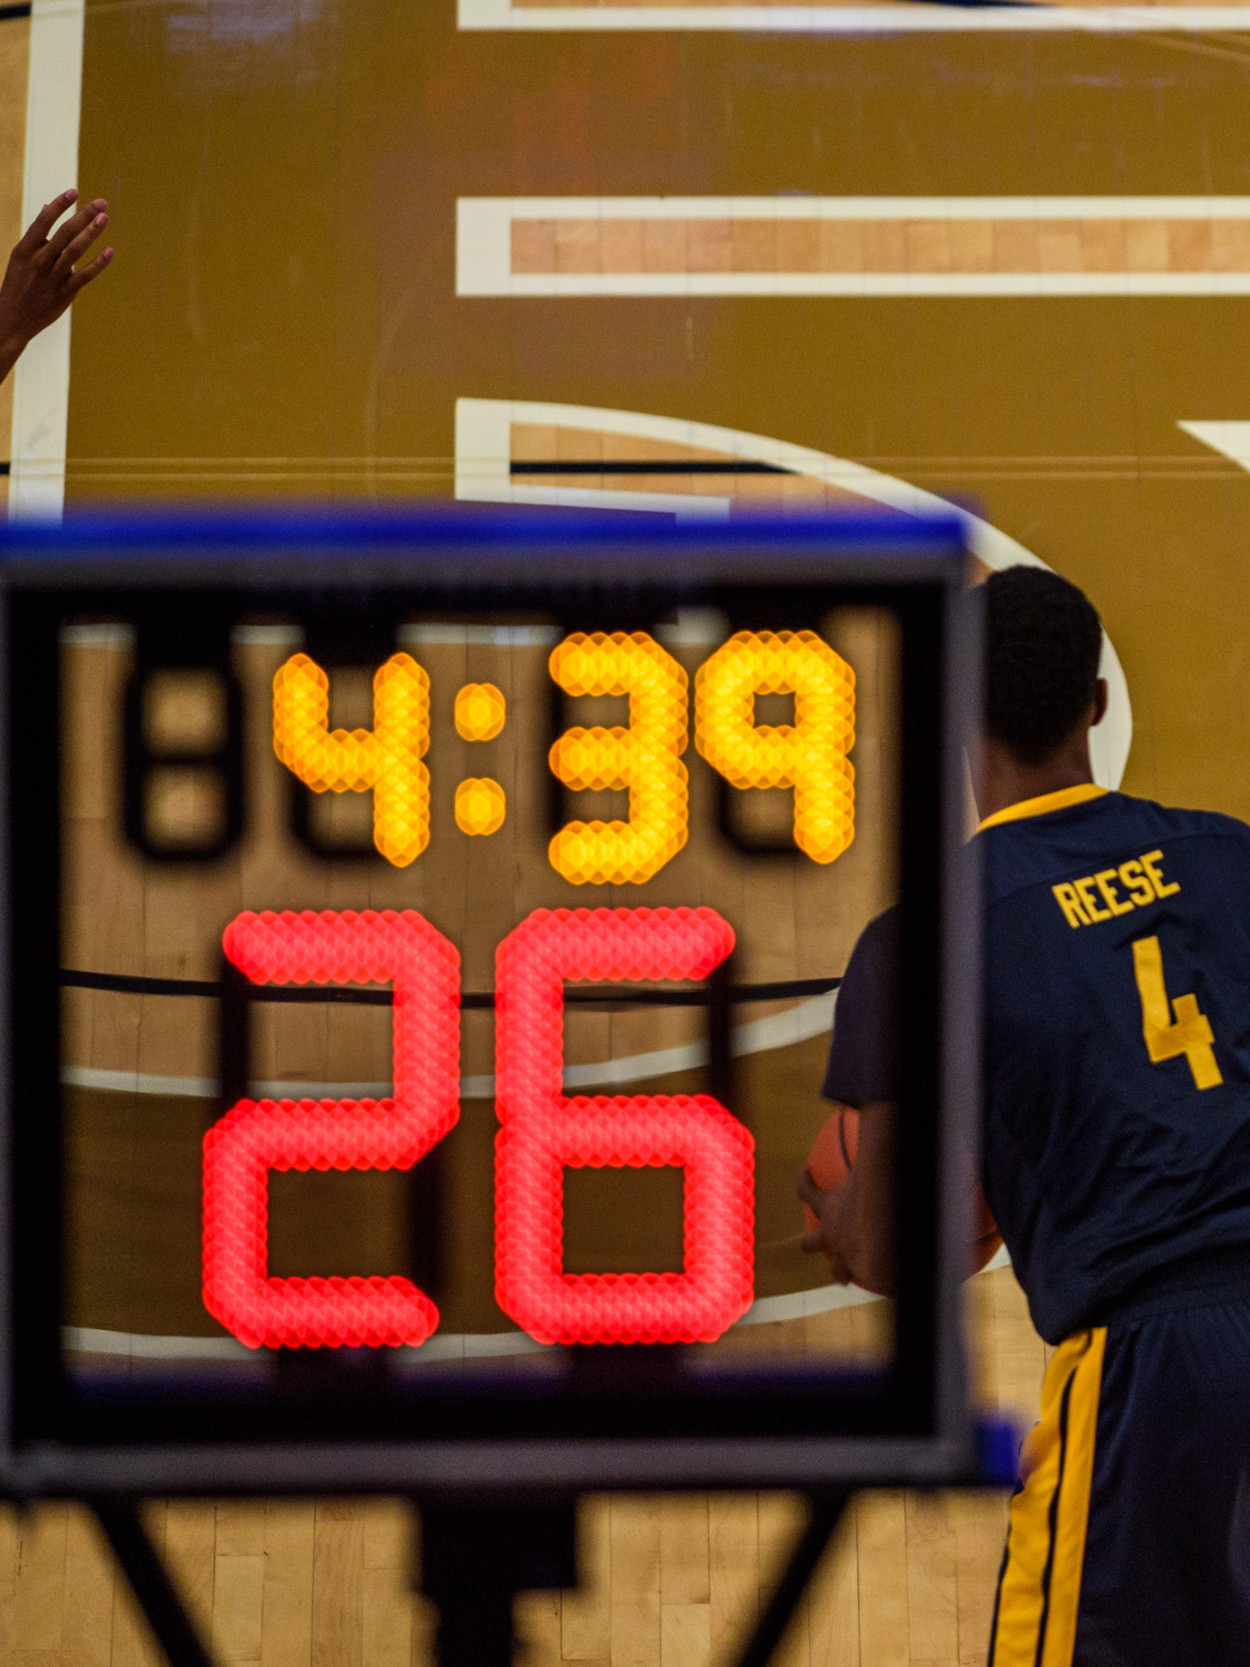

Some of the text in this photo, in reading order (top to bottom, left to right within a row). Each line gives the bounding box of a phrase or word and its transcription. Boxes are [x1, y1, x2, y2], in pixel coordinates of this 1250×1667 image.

[273, 630, 855, 885] 4:39
[1051, 849, 1181, 929] REESE
[1131, 935, 1224, 1091] 4
[202, 906, 755, 1349] 26
